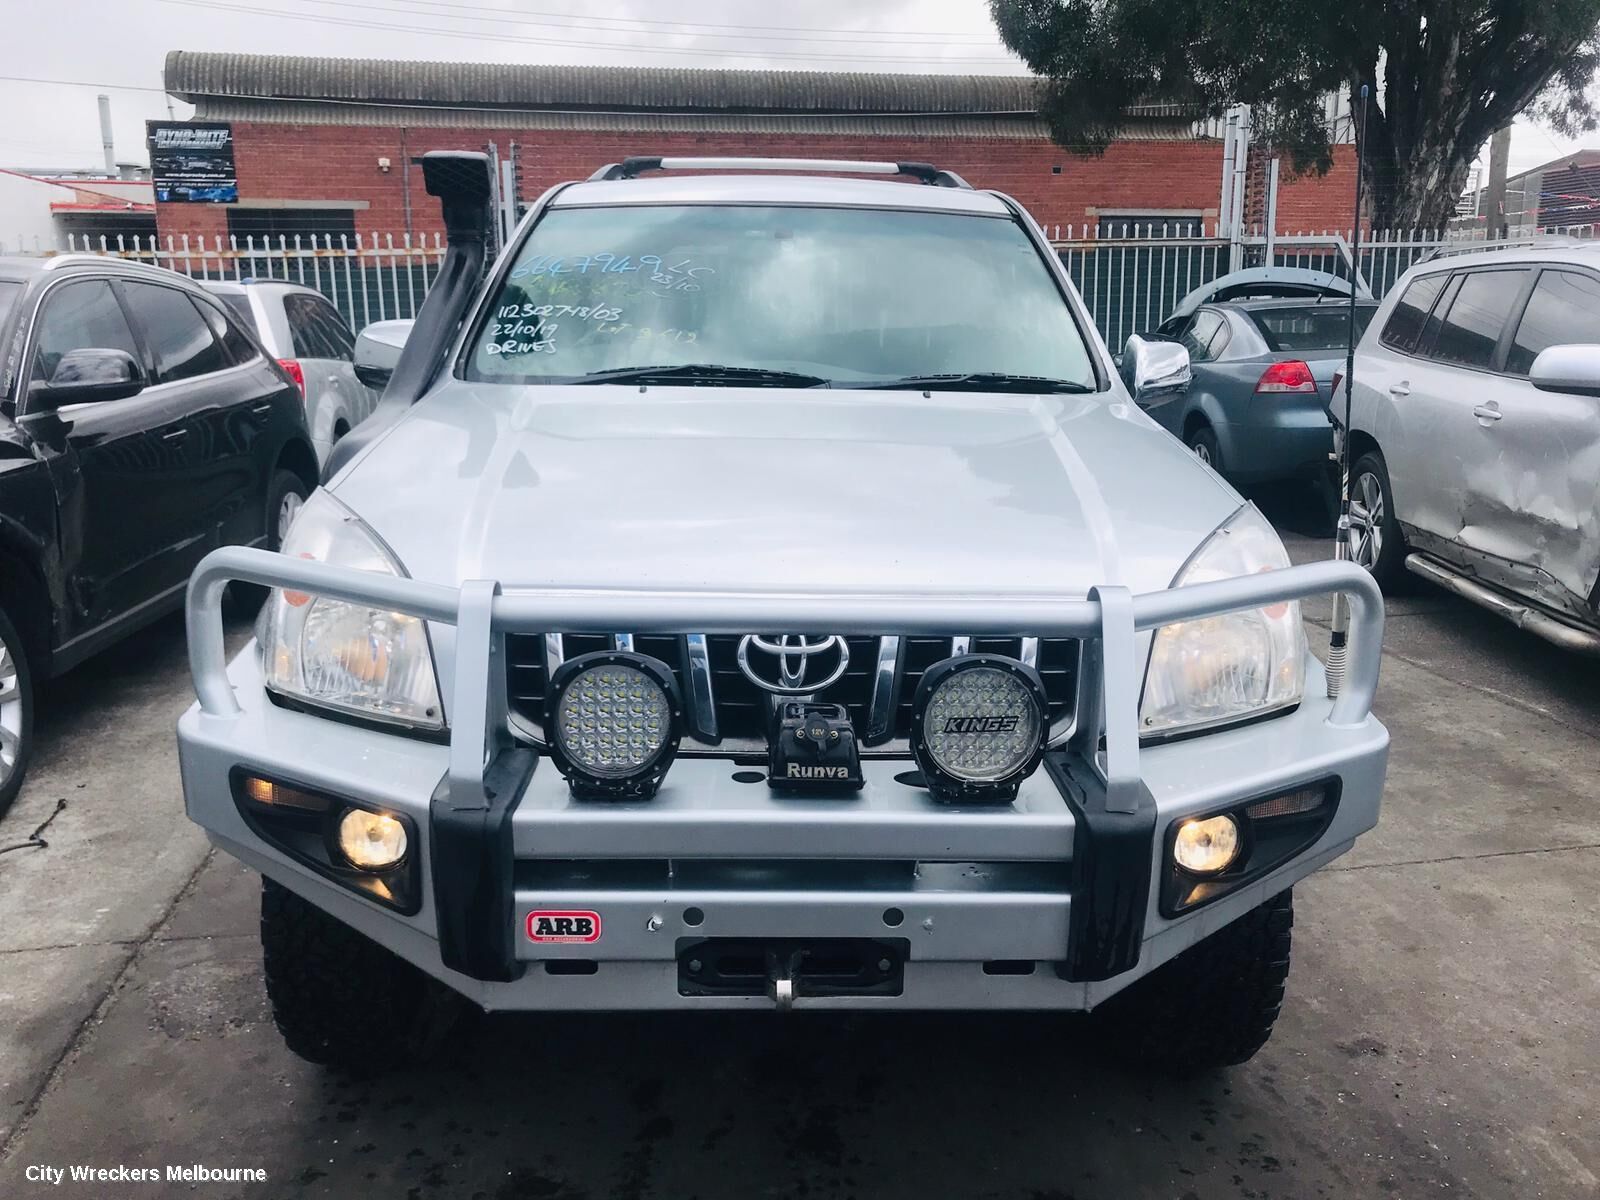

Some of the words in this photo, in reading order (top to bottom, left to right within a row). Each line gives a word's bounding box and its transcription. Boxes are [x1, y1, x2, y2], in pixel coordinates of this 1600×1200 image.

[155, 129, 229, 143] DYNO-MITE
[490, 319, 558, 338] 22/10/19
[944, 715, 1020, 734] KINGS
[786, 763, 849, 779] Runva
[535, 917, 593, 936] ARB
